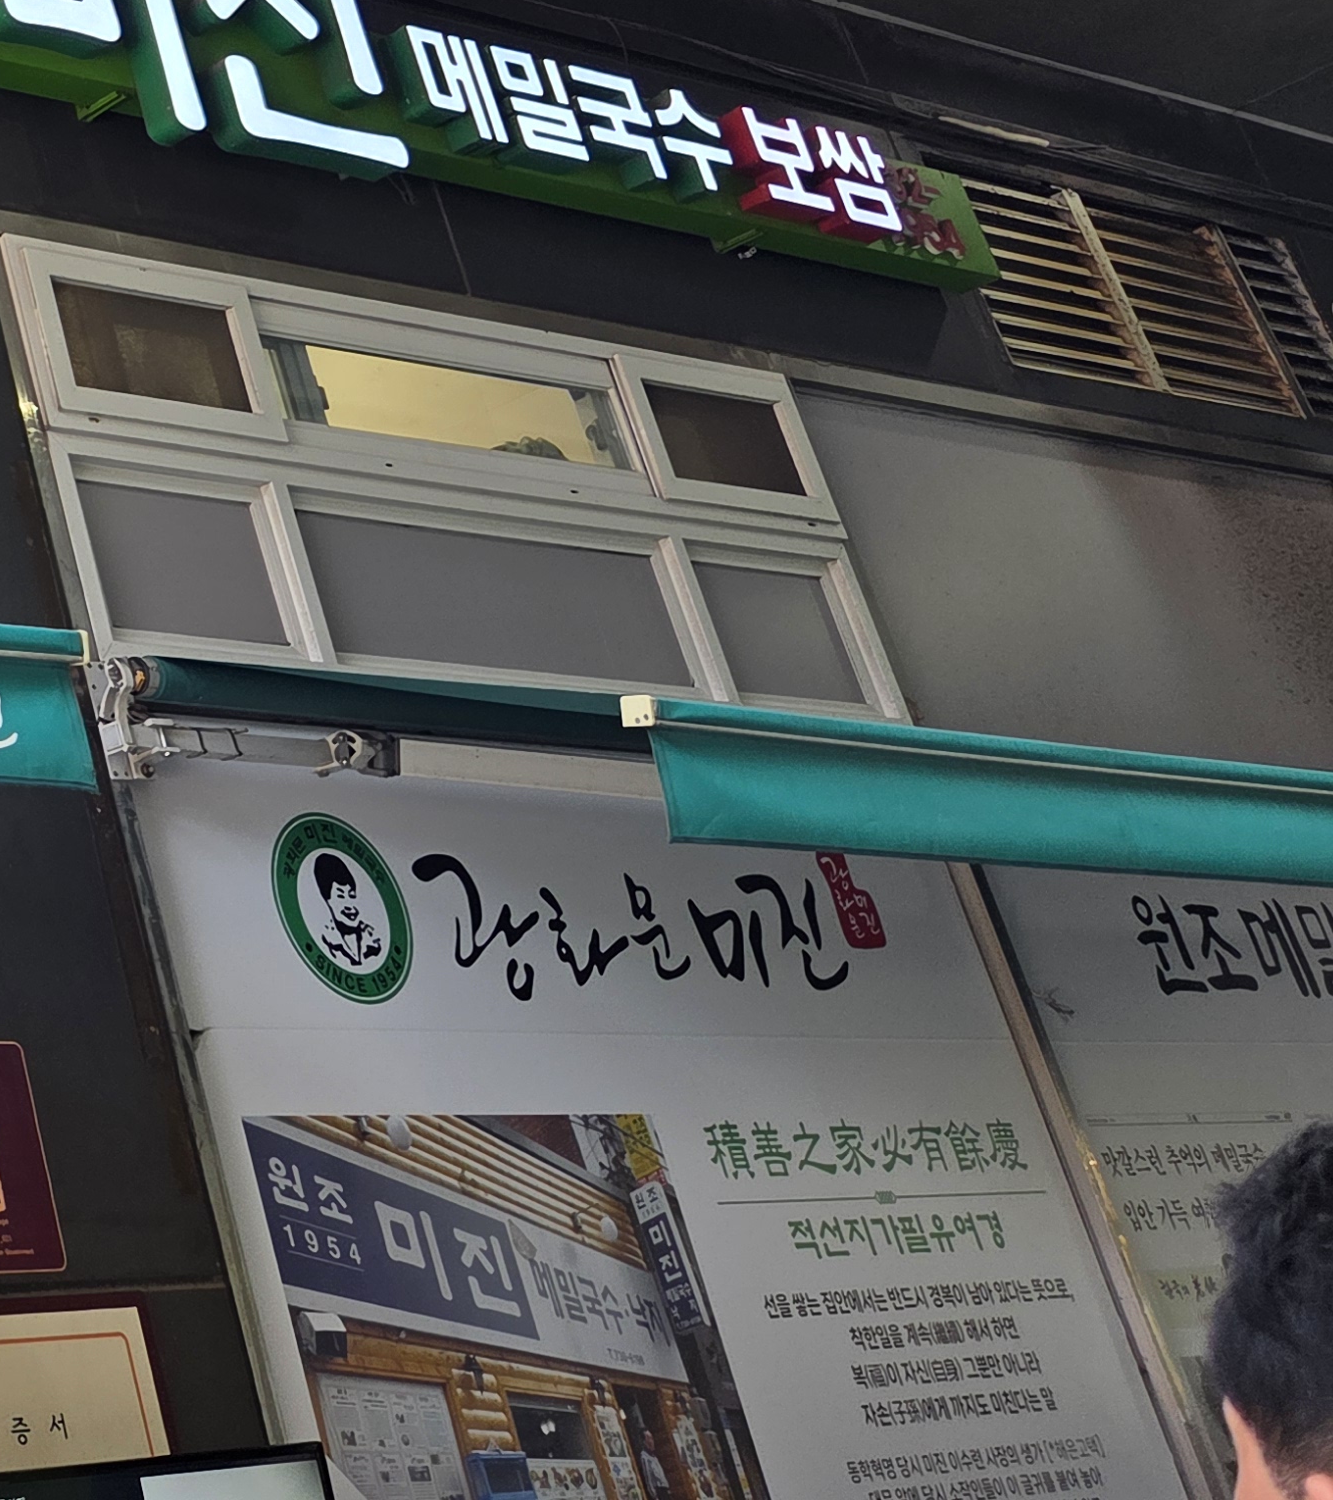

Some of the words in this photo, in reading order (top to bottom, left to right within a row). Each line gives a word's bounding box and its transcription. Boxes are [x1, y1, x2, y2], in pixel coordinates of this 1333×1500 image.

[406, 24, 734, 192] 메밀국수
[739, 105, 904, 233] 보쌈
[314, 953, 369, 994] SINCE
[371, 955, 404, 993] 1954
[267, 1155, 354, 1225] 원조
[282, 1223, 363, 1266] 1954
[372, 1199, 523, 1319] 미진
[786, 1210, 1006, 1260] 적선지가필유여경
